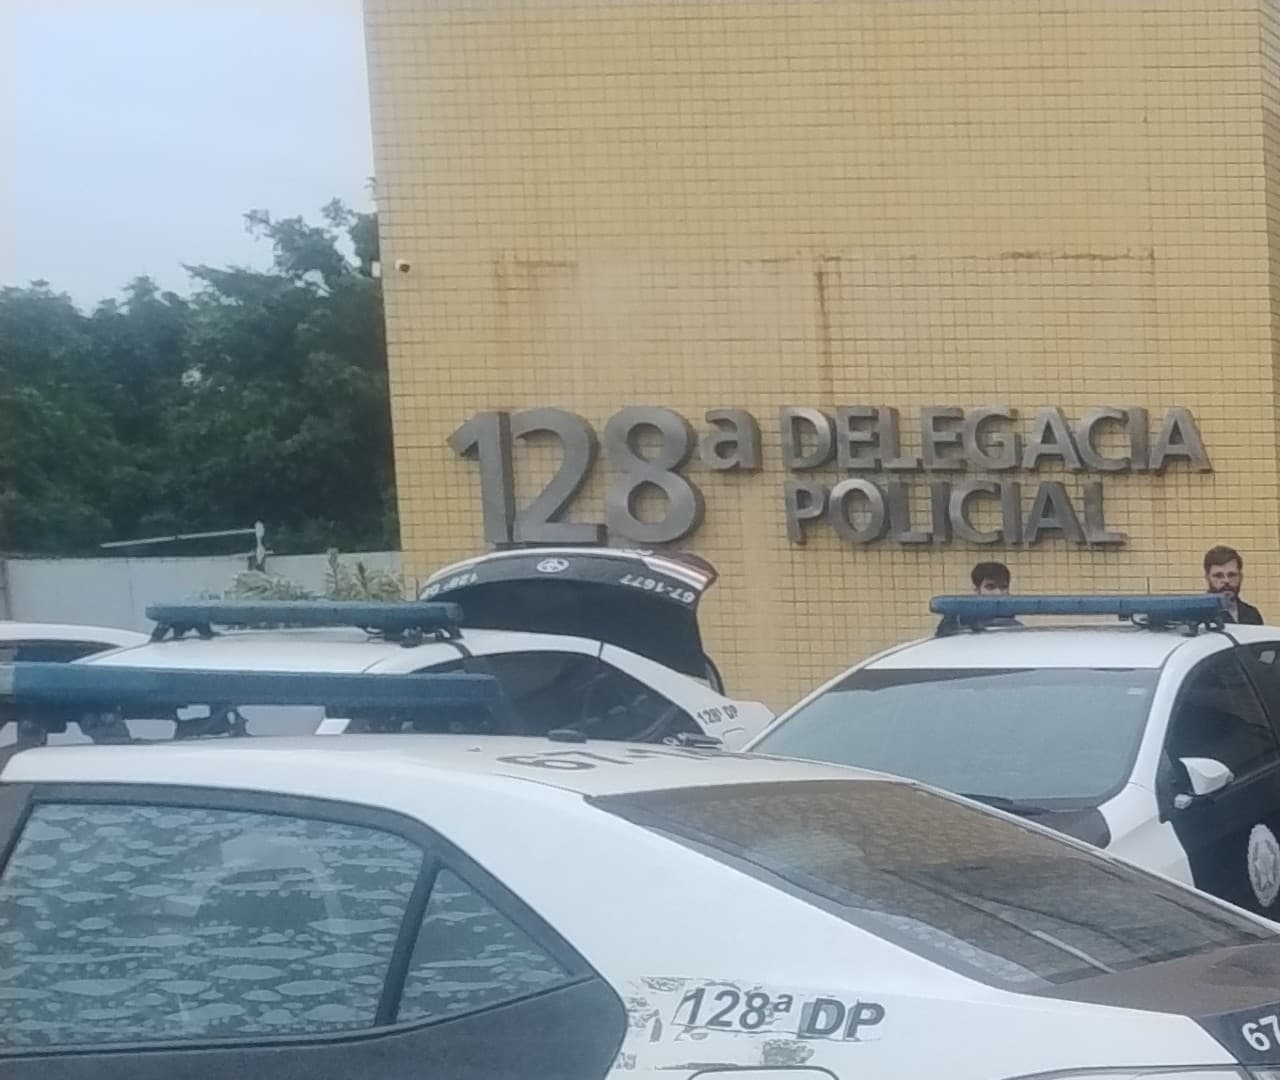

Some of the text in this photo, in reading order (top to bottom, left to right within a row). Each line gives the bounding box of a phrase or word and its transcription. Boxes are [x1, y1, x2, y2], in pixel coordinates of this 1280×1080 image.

[780, 405, 1213, 473] DELEGACIA
[784, 478, 1129, 547] POLICIAL
[619, 573, 696, 604] 67-1677
[803, 997, 886, 1040] DP
